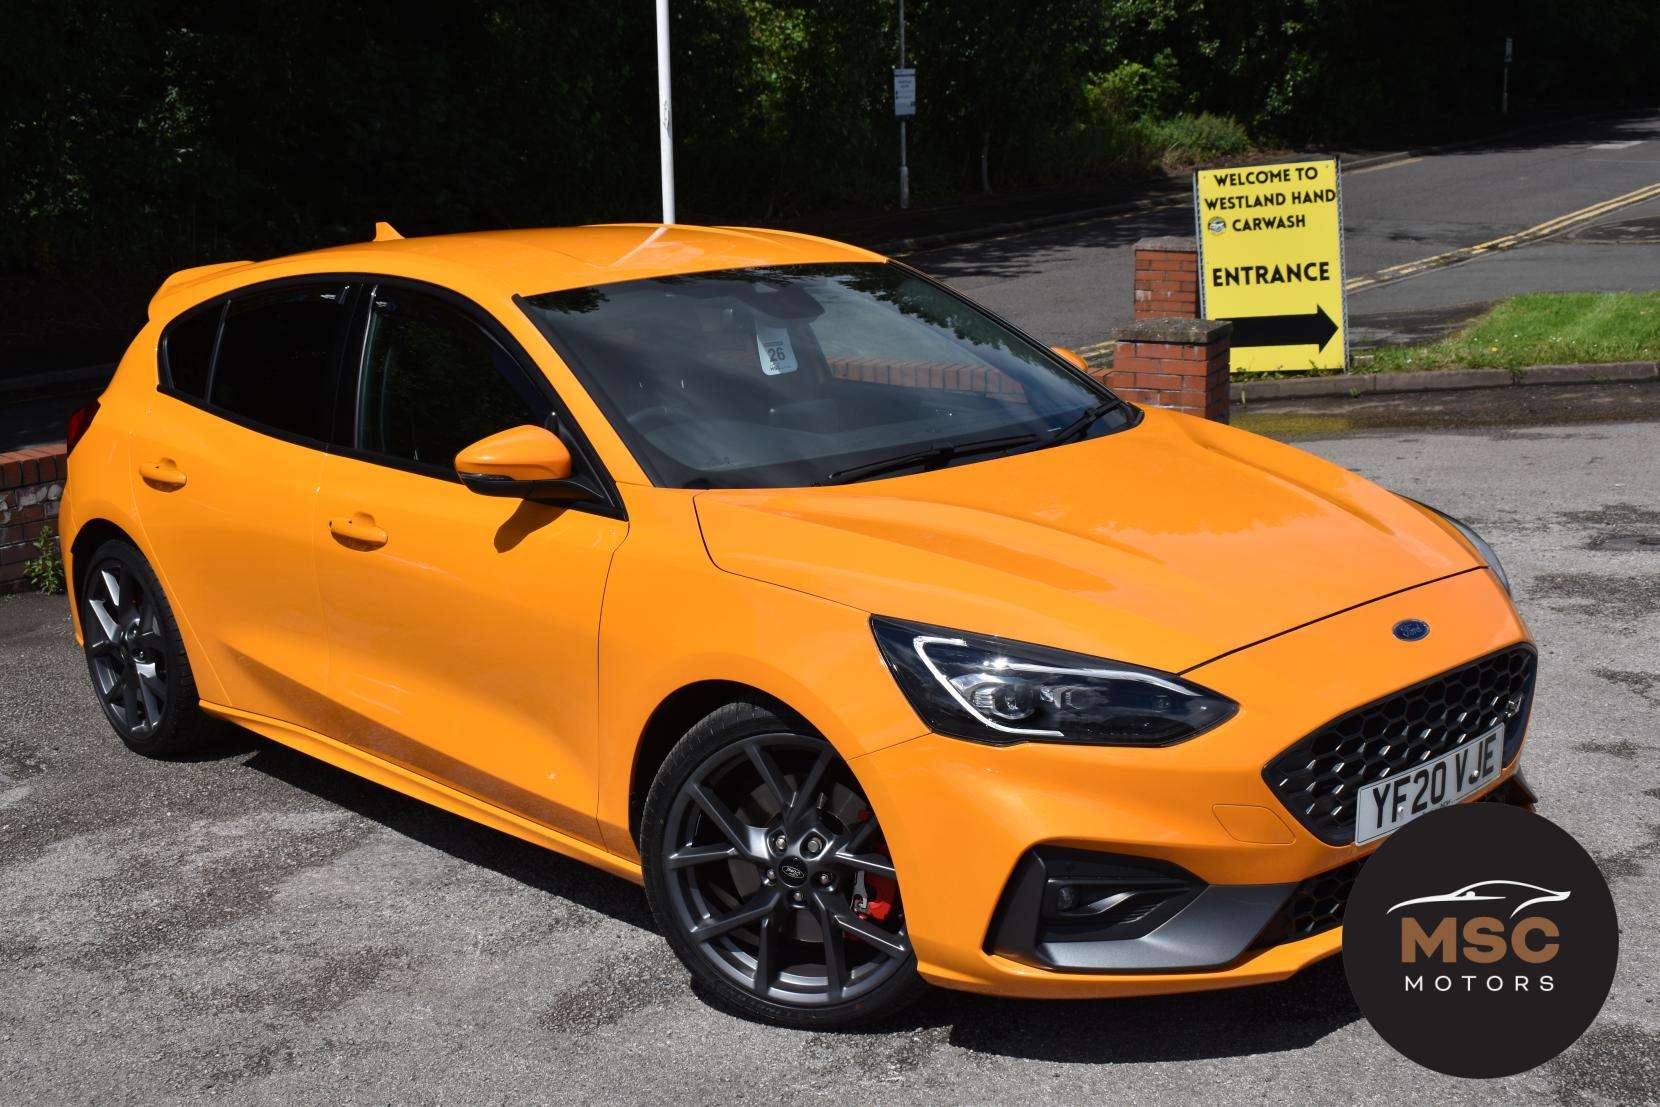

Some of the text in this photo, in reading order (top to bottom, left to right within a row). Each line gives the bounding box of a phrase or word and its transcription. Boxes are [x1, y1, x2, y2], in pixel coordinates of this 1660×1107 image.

[1213, 166, 1318, 187] WELCOME TO
[1204, 189, 1336, 210] WESTLAND HAND
[1232, 215, 1306, 232] CARWASH
[1212, 261, 1330, 287] ENTRANCE
[767, 347, 785, 362] 26
[1372, 733, 1497, 829] YF20 VJE
